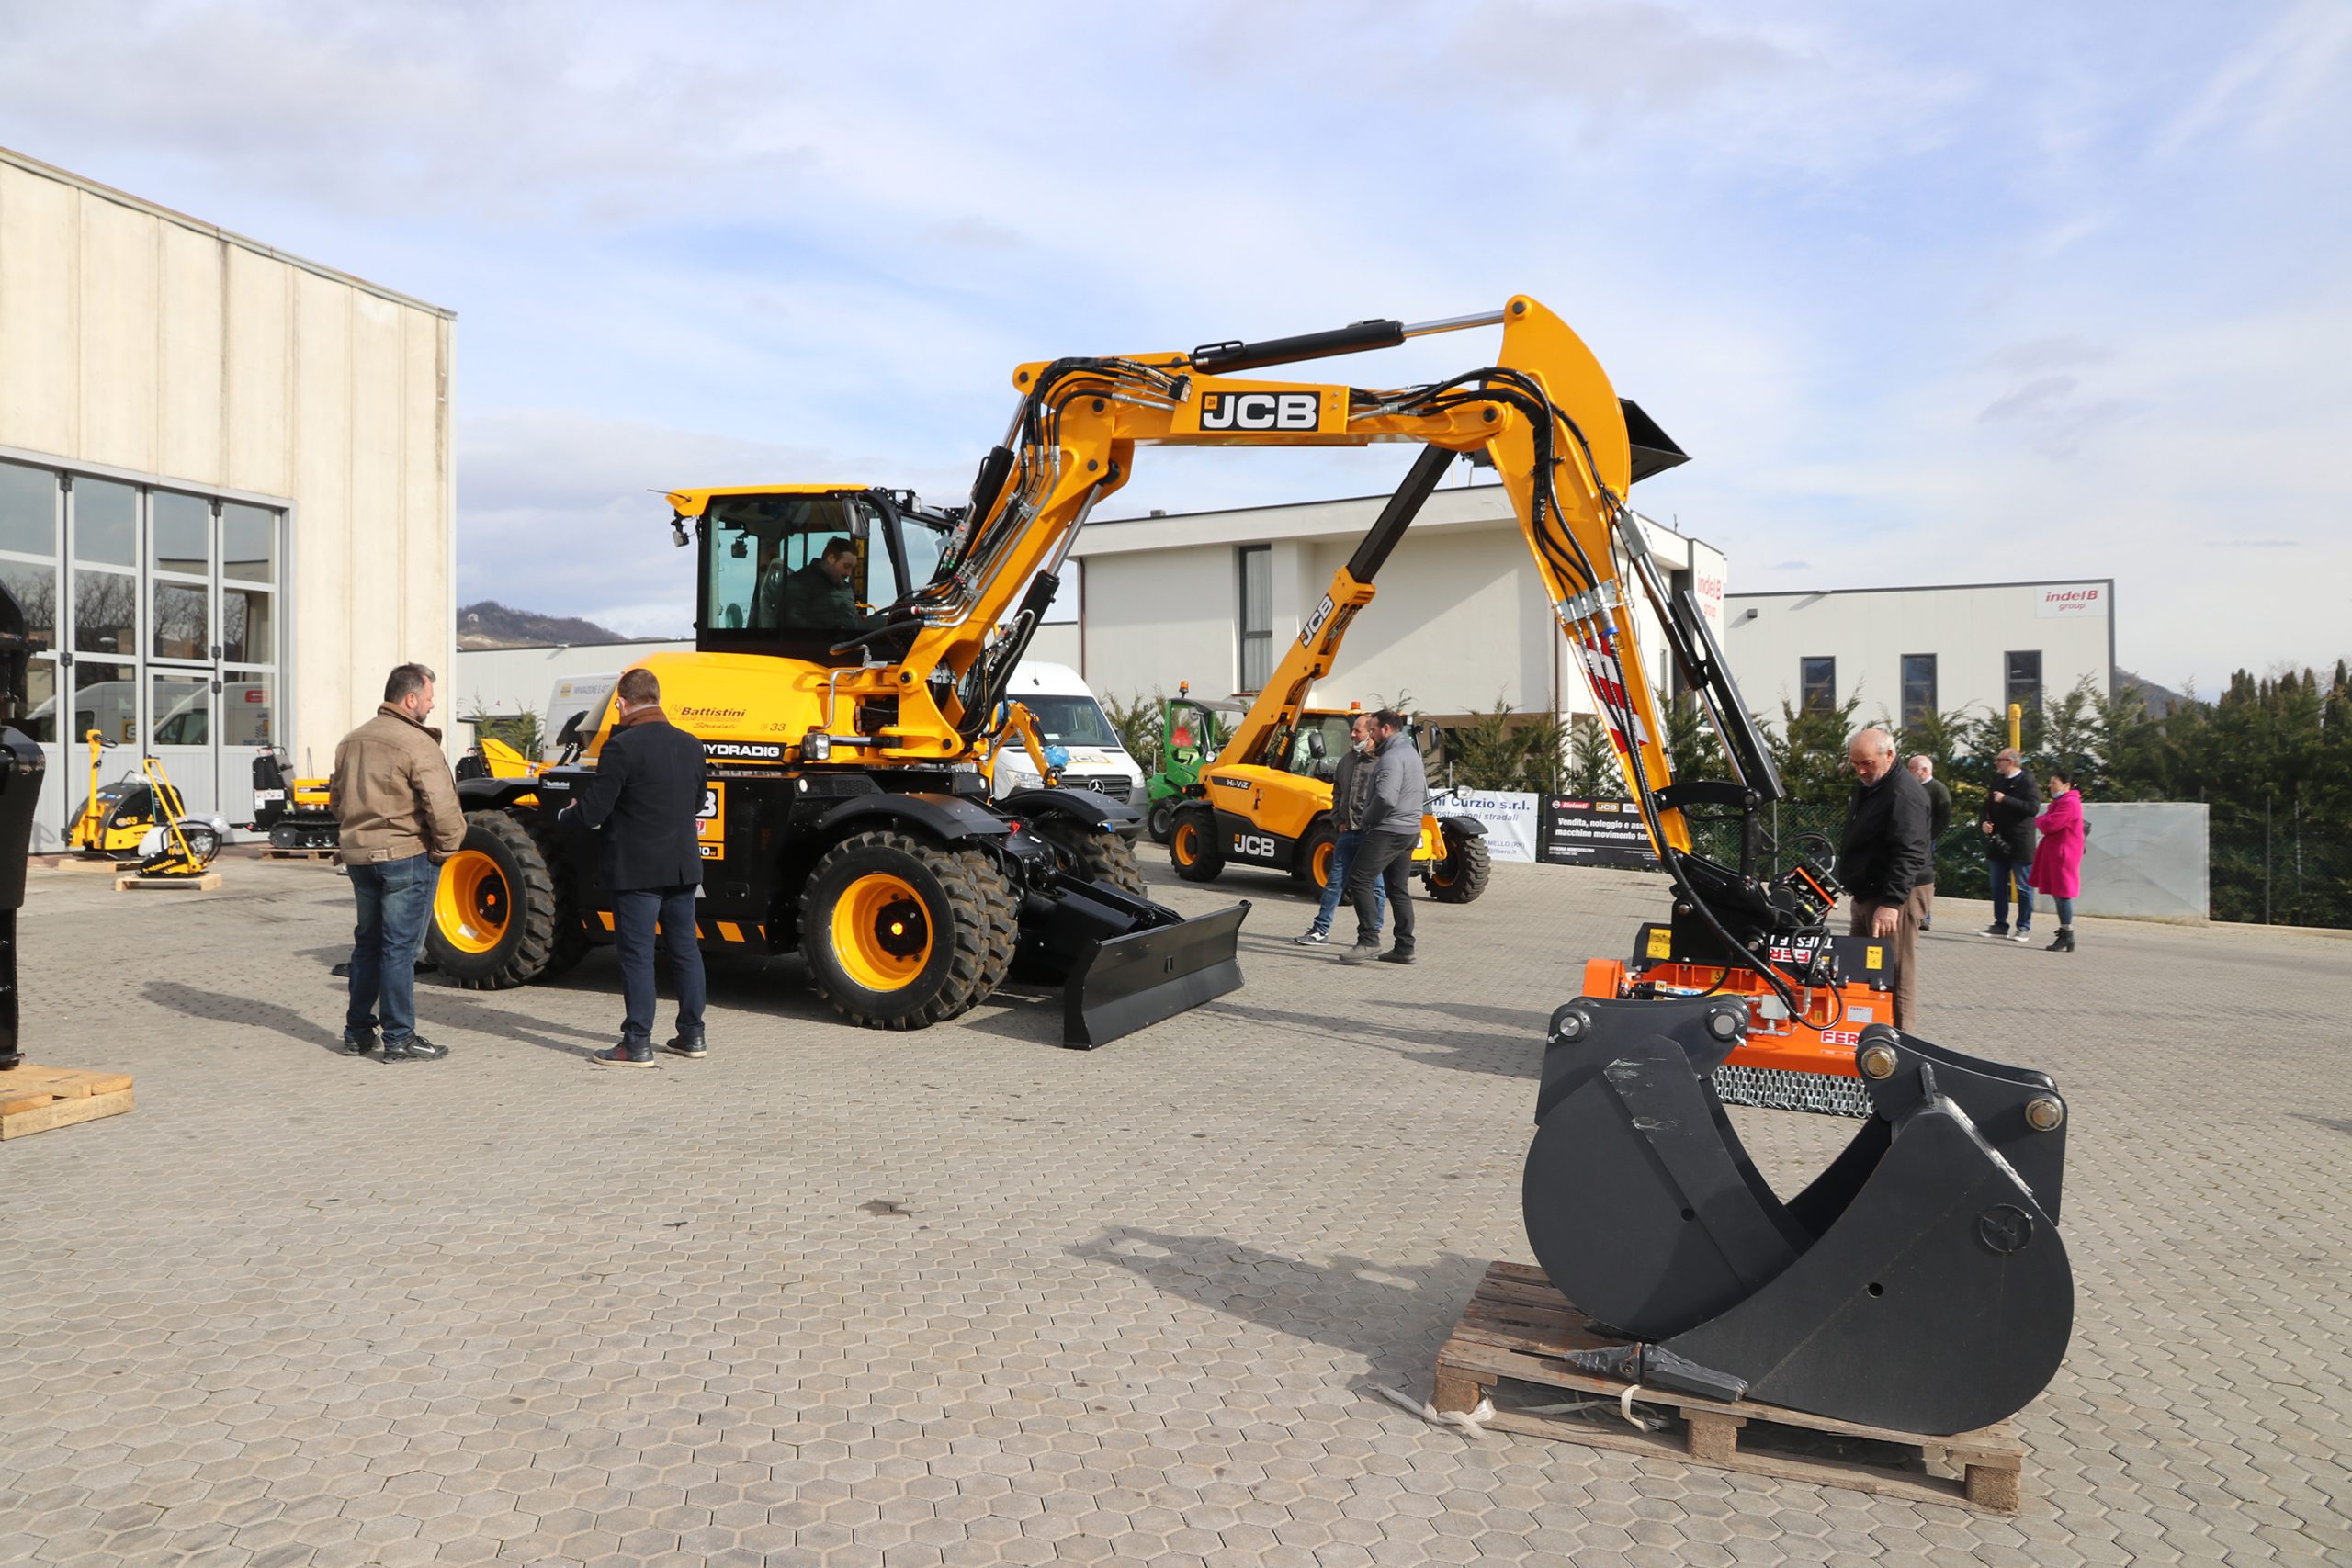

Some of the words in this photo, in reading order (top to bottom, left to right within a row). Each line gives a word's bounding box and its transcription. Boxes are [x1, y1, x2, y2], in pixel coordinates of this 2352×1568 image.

[1204, 395, 1317, 428] JCB
[2058, 603, 2086, 612] group
[1302, 595, 1334, 648] JCB
[681, 707, 746, 717] Battistini
[770, 723, 786, 731] 33
[1452, 797, 1495, 808] Curzio
[1499, 800, 1530, 811] s.r.l.
[1484, 813, 1519, 821] stradali
[1558, 818, 1589, 828] Vendita,
[1590, 819, 1623, 829] noleggio
[1555, 829, 1592, 838] macchine
[1593, 830, 1636, 840] movimento
[1637, 831, 1651, 840] ter
[1234, 834, 1275, 858] JCB
[1770, 948, 1810, 963] FER
[1822, 1031, 1858, 1044] FER
